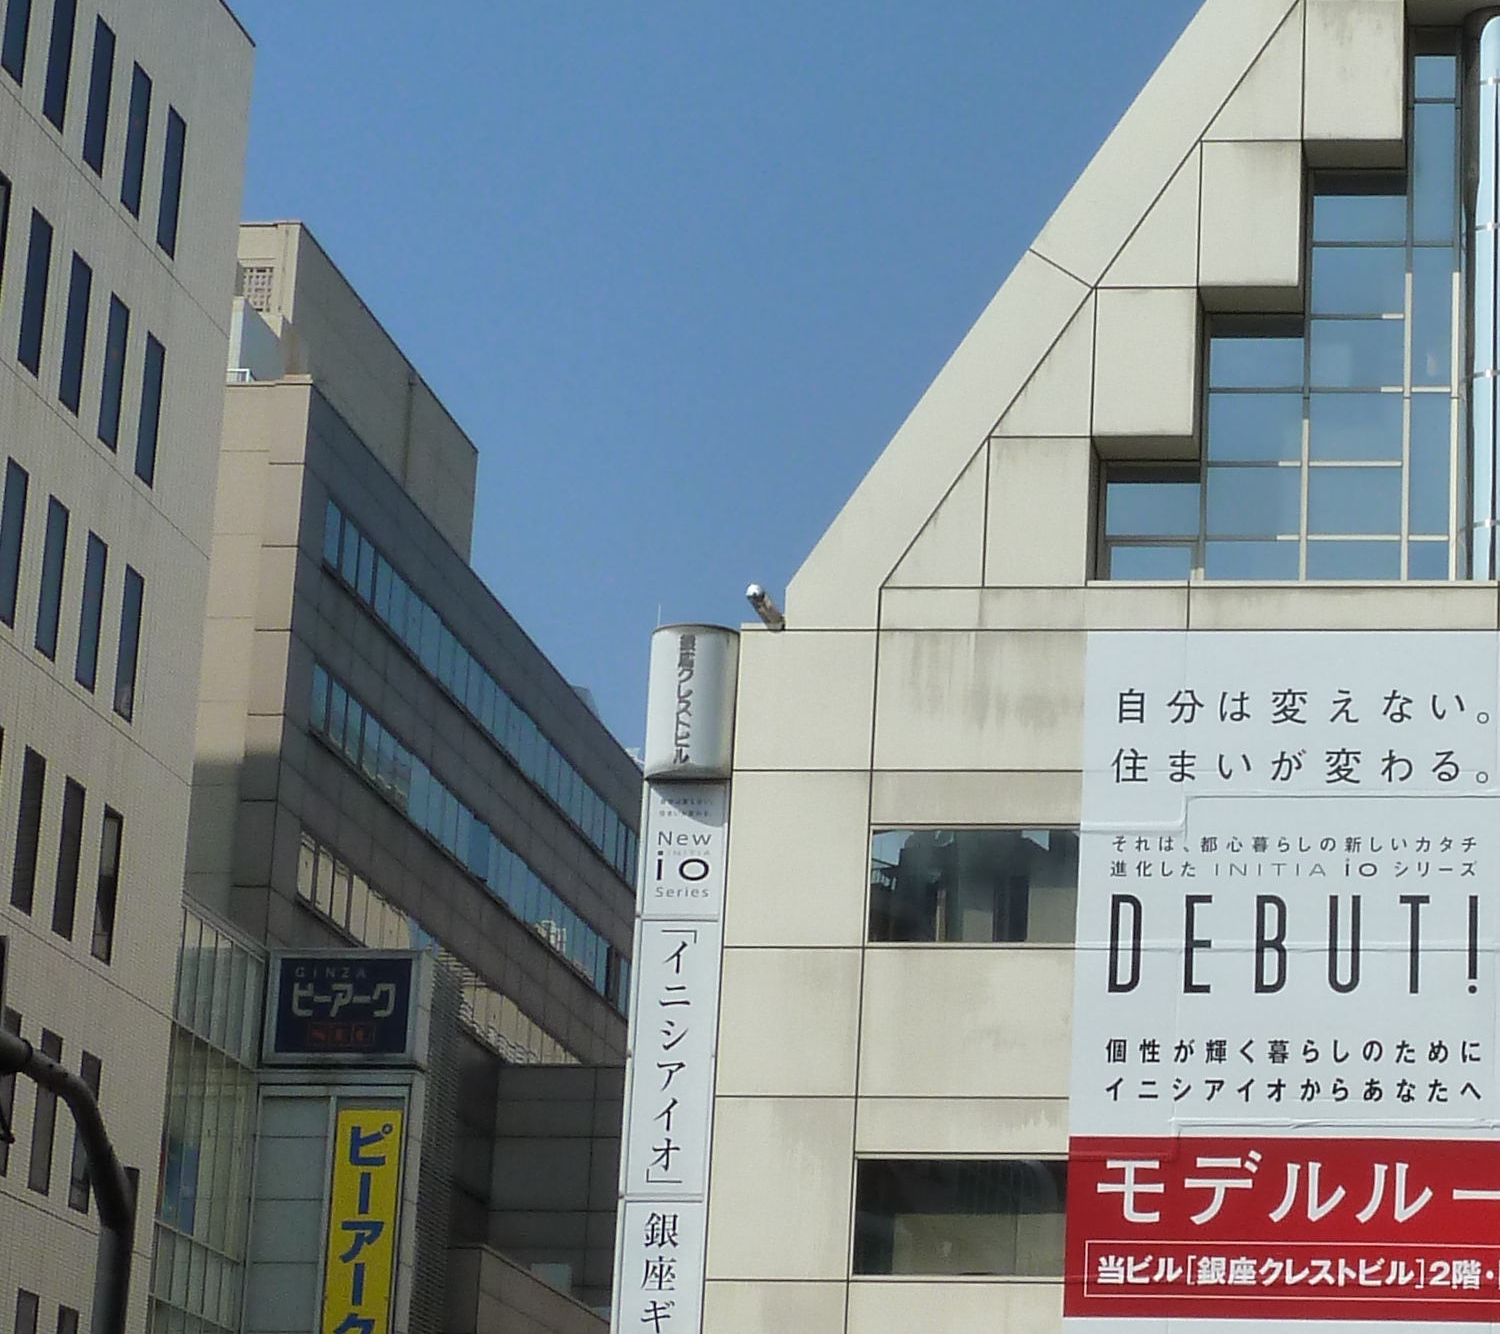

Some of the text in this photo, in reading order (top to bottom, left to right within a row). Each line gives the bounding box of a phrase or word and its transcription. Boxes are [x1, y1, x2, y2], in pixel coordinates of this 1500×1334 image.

[1115, 686, 1492, 726] 自分は変えない。
[1110, 746, 1490, 785] 住まいが変わる。
[658, 830, 712, 846] New
[1111, 835, 1478, 854] それは、都心暮らしの新しいカタチ
[656, 849, 710, 881] io
[1110, 858, 1478, 878] 進化した INITIA io シリーズ
[655, 886, 709, 898] Series
[1107, 894, 1480, 996] DEBUT!
[294, 967, 367, 979] GINZA
[1105, 1037, 1482, 1066] 個性が輝く暮らしのために
[1105, 1075, 1483, 1105] イニシアイオからあなたへ
